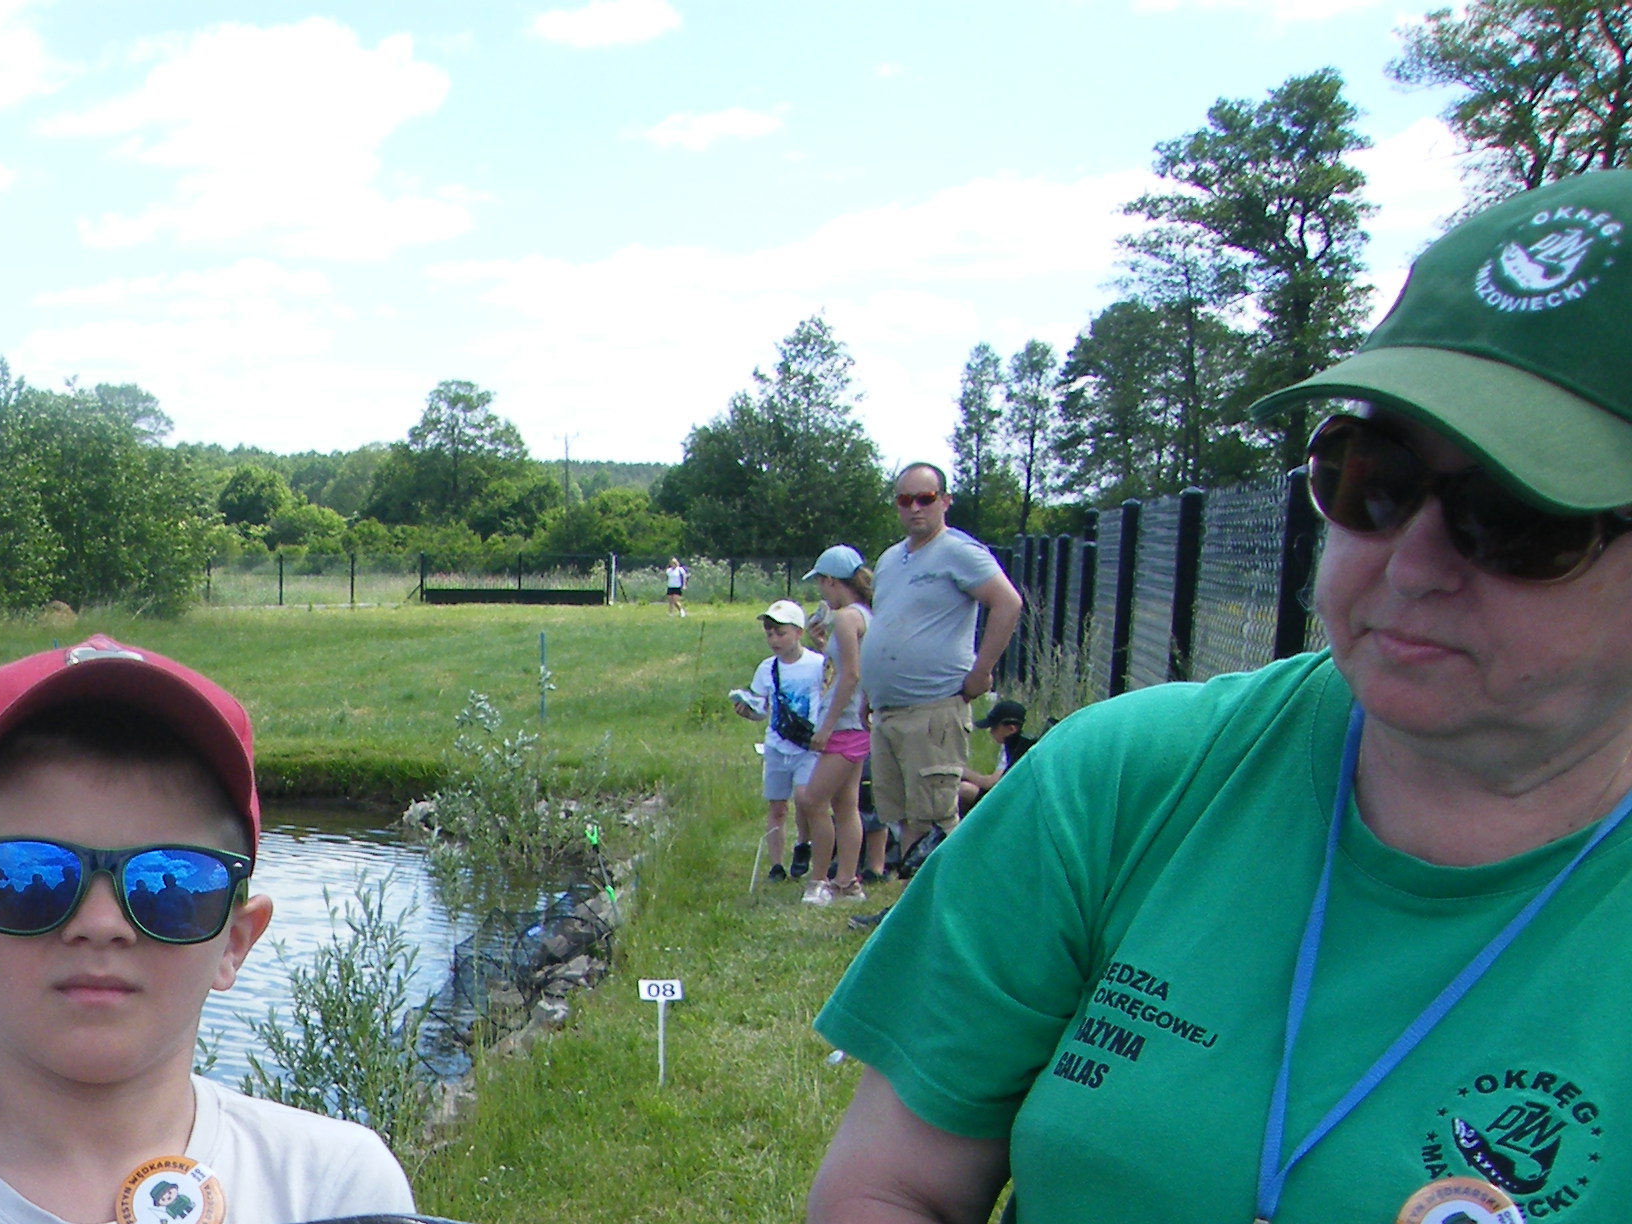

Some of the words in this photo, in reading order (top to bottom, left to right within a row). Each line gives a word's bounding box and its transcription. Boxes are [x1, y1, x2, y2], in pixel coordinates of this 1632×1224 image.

[1530, 206, 1623, 237] OKRĘG
[1475, 258, 1589, 312] MAZOWIECKI
[647, 983, 675, 998] 08
[1104, 961, 1170, 1001] ĘDZIA
[1074, 1015, 1146, 1062] AŻYNA
[1093, 987, 1219, 1049] OKRĘGOWEJ
[1474, 1069, 1600, 1125] OKRĘG
[1485, 1100, 1568, 1155] PZW
